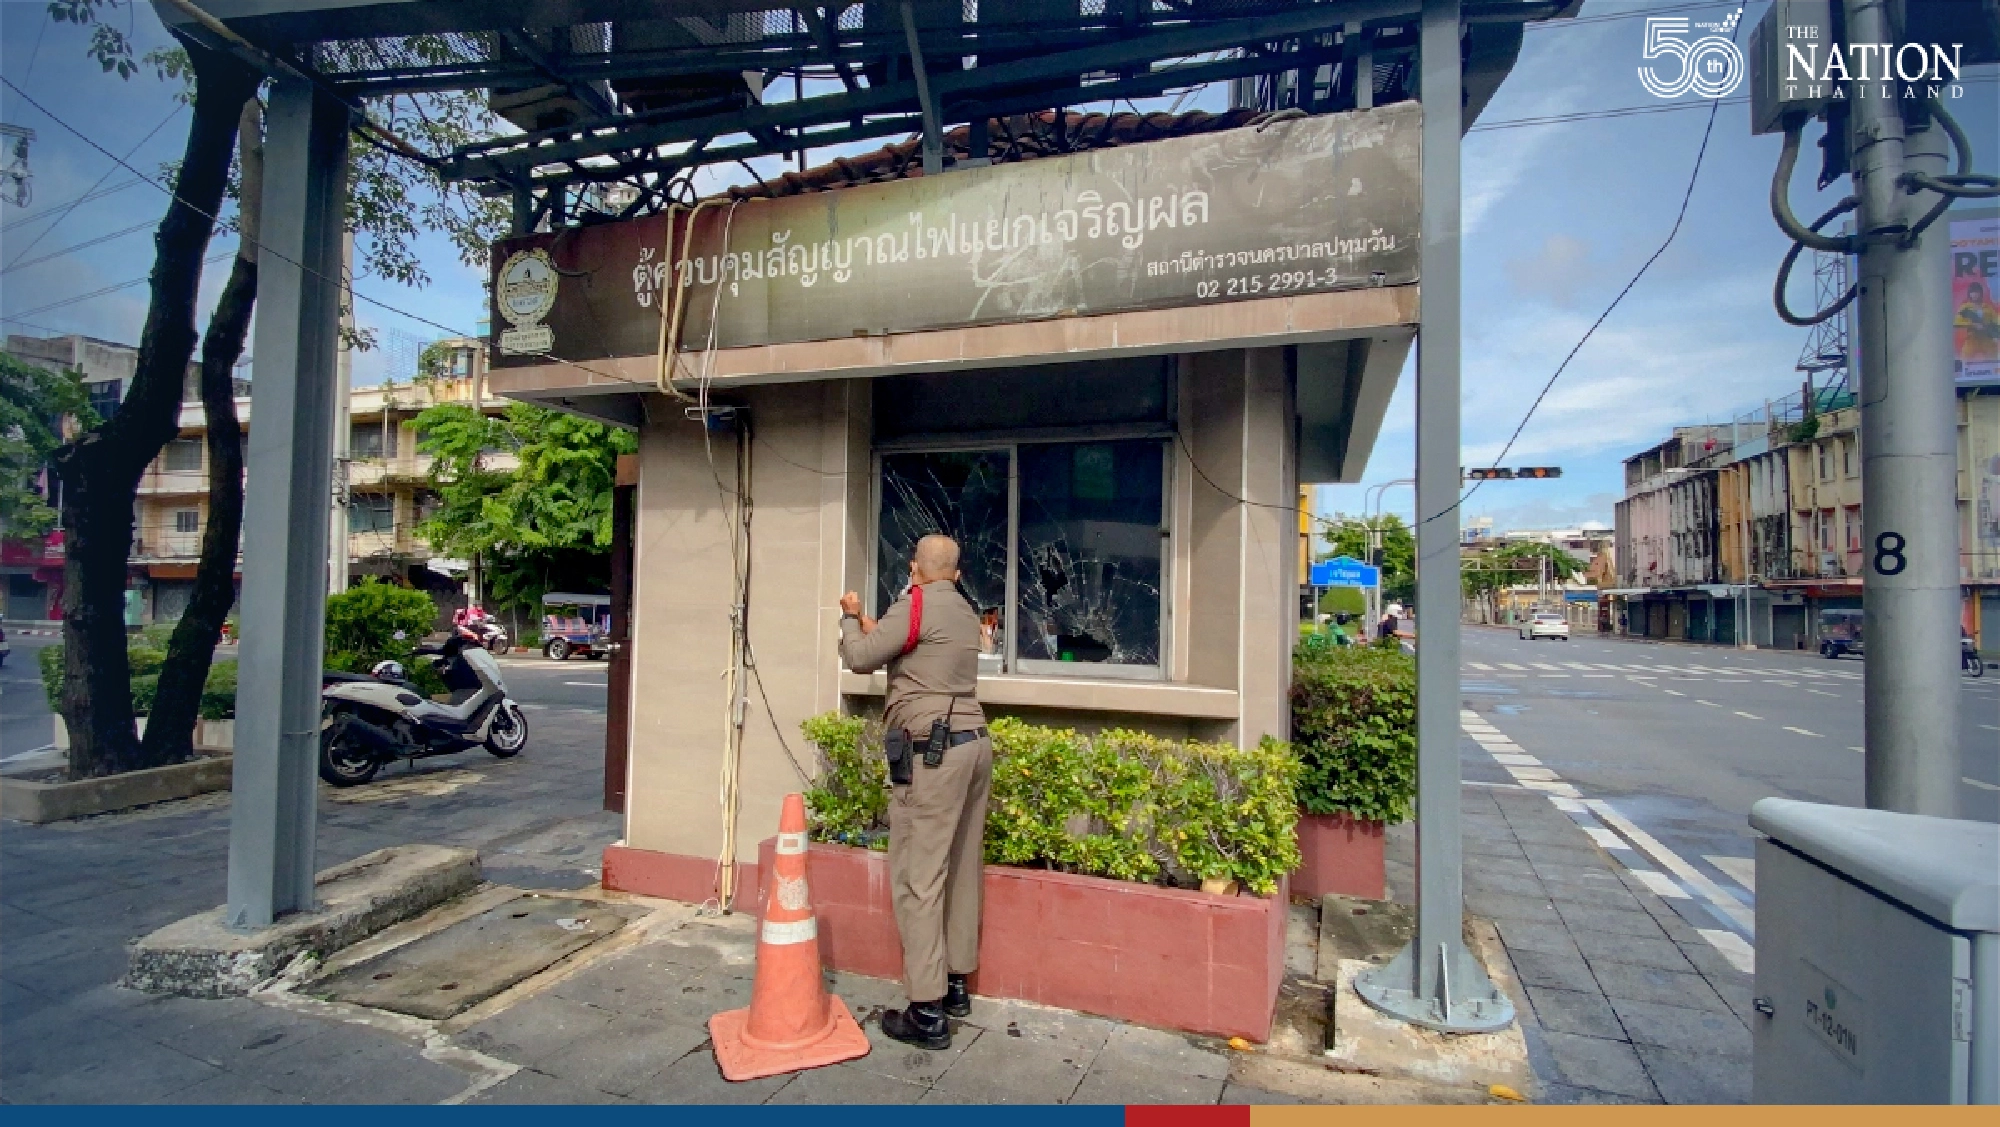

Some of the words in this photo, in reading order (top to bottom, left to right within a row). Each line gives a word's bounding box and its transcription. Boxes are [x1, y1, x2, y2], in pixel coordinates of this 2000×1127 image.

[632, 189, 1209, 307] ตู้ควบคุมสัญญาณไฟแยกเจริญผล
[1147, 228, 1396, 277] สถานีตำรวจนครบาลปทุมวัน
[1197, 280, 1220, 298] 02
[1227, 275, 1262, 296] 215
[1269, 267, 1337, 291] 2991-3
[1874, 531, 1907, 575] 8
